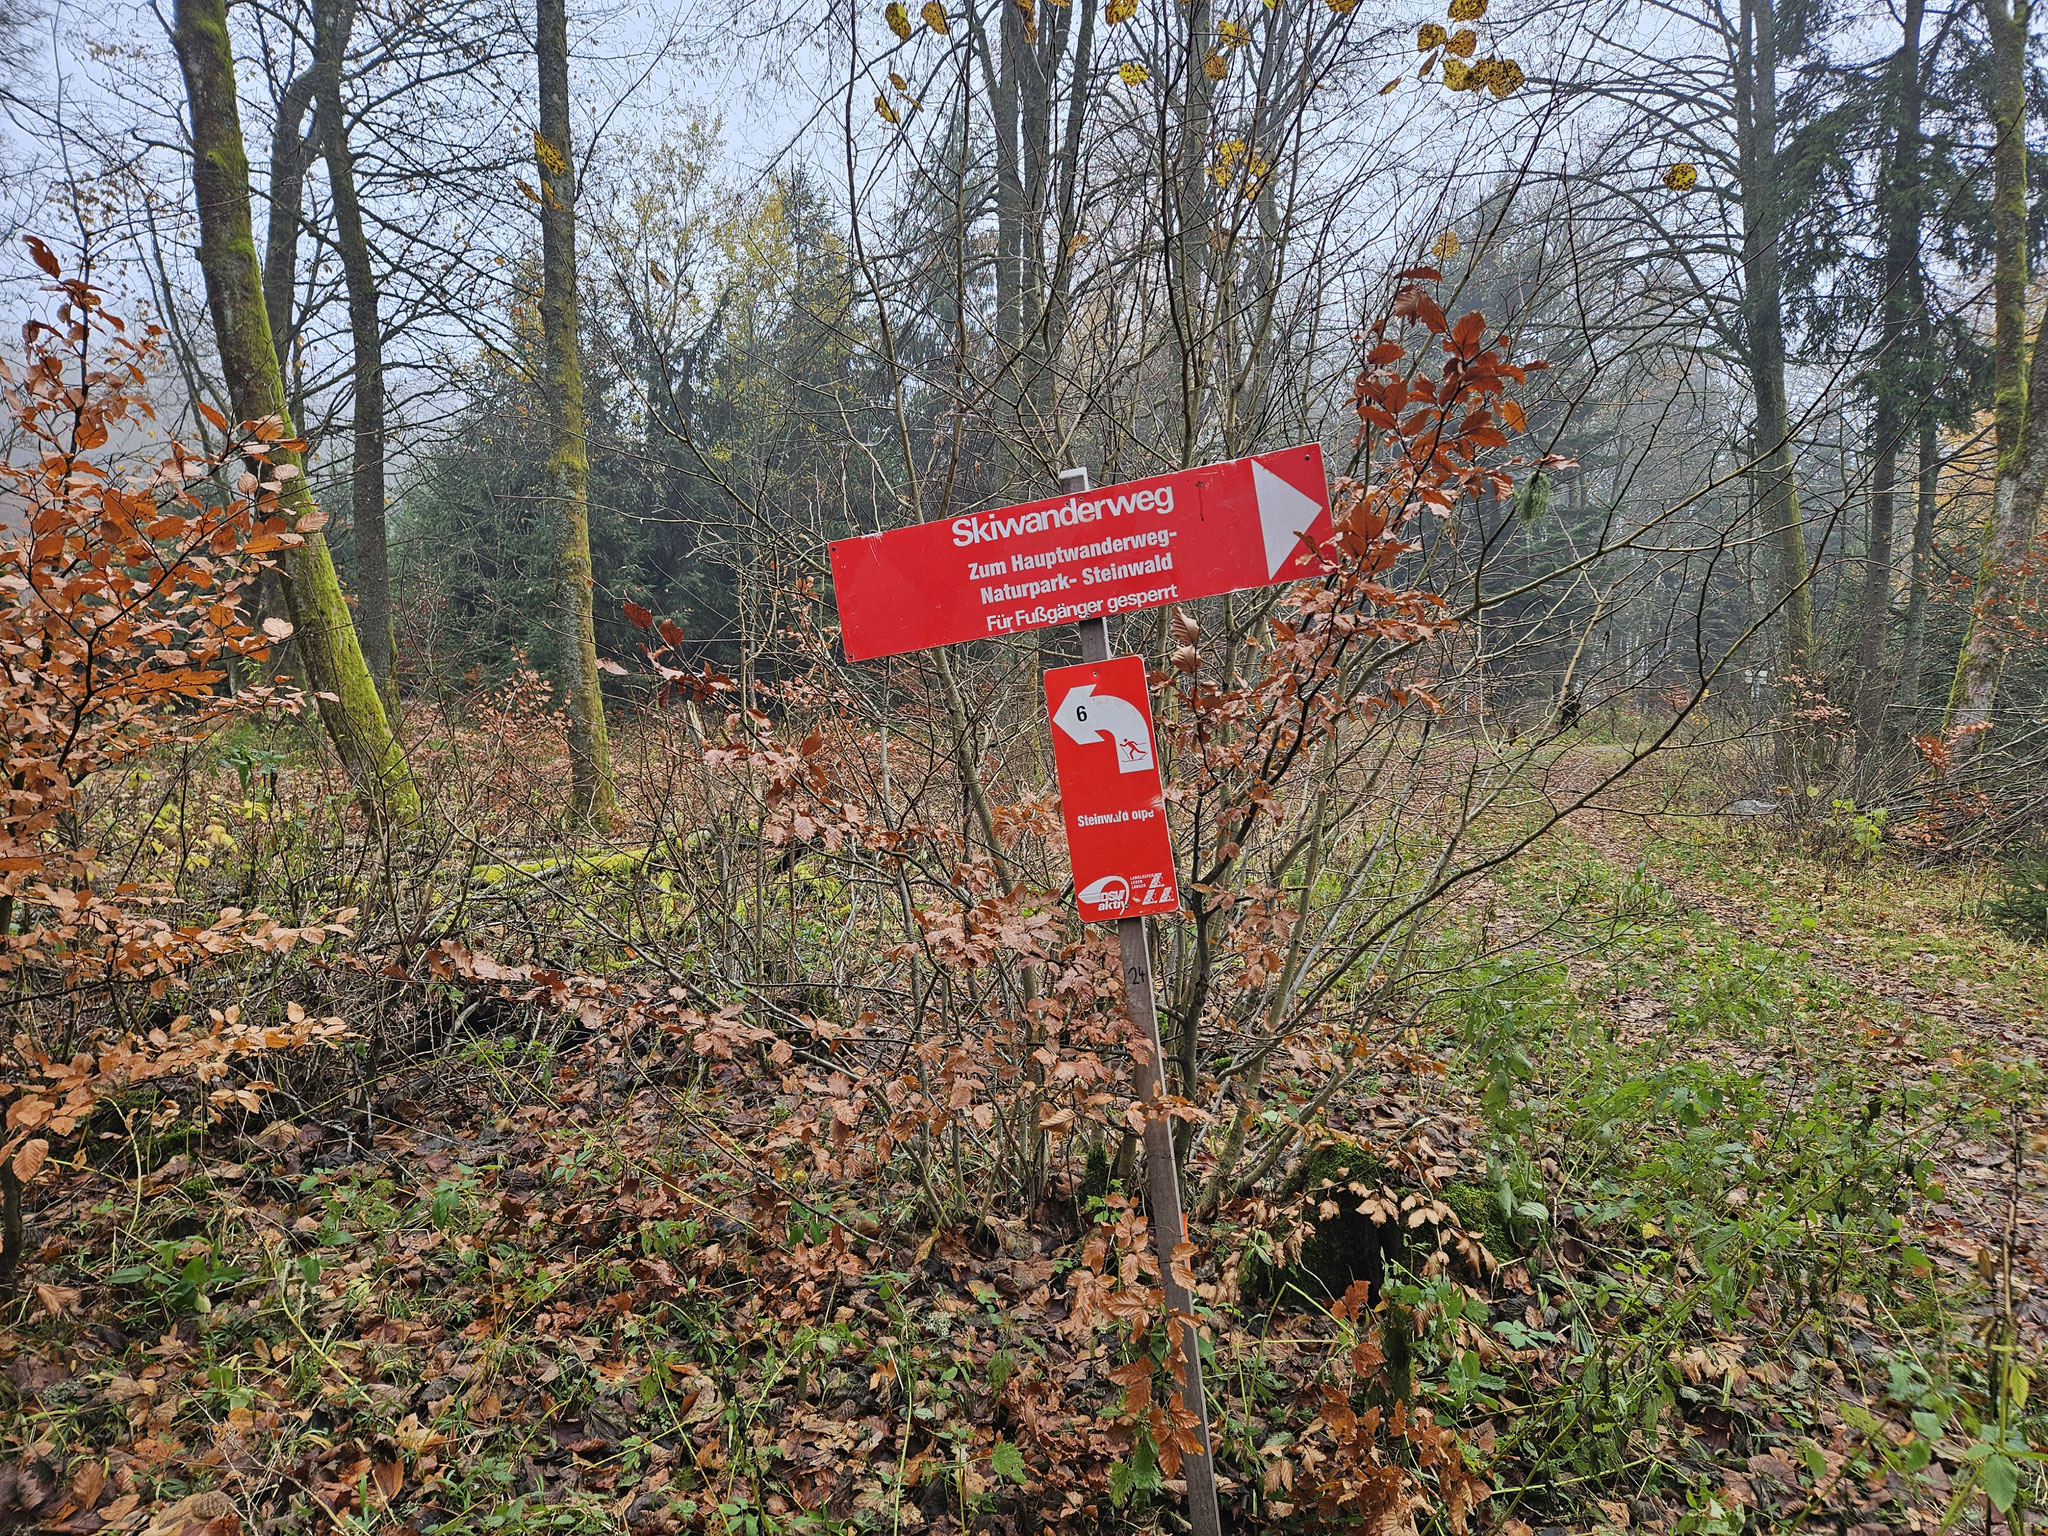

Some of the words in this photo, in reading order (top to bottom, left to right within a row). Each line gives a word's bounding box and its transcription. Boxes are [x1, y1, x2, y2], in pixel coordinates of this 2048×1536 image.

[951, 486, 1175, 547] Skiwanderweg
[967, 561, 1007, 581] Zum
[1011, 530, 1178, 573] Hauptwanderweg-
[980, 574, 1078, 605] Naturpark-
[1081, 552, 1174, 586] Steinwald
[986, 613, 1013, 632] Für
[1016, 599, 1104, 627] Fußgänger
[1107, 584, 1179, 613] gesperrt
[1076, 706, 1088, 722] 6
[1098, 899, 1125, 912] aktiv
[1100, 889, 1125, 902] DSV
[1128, 966, 1146, 985] 24
